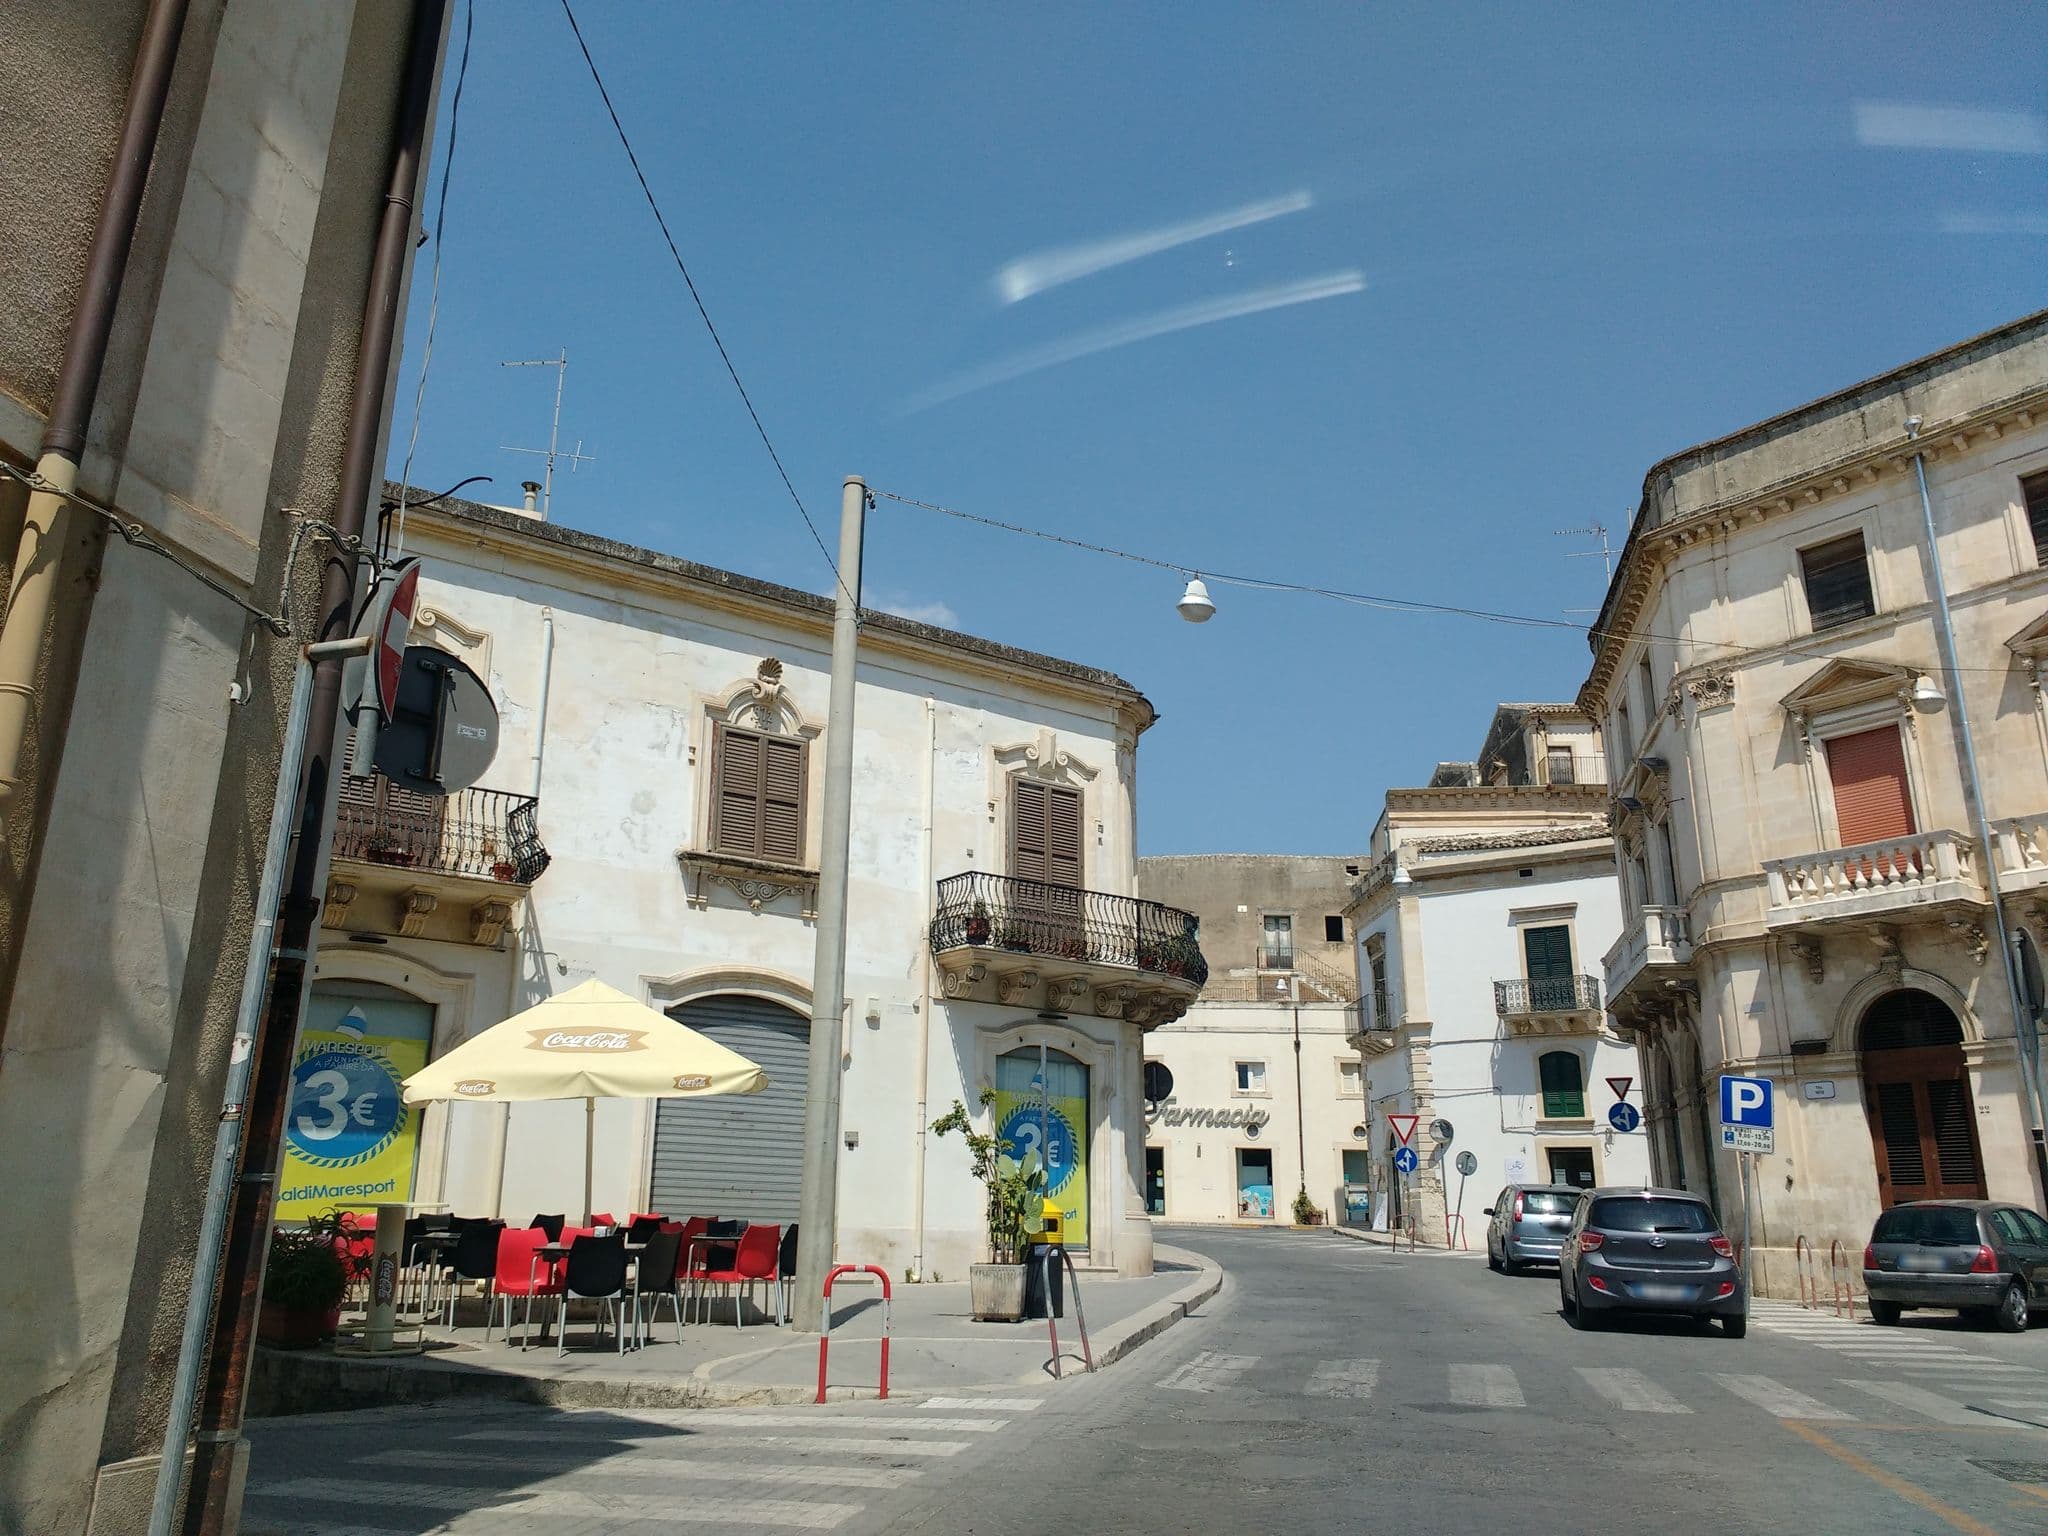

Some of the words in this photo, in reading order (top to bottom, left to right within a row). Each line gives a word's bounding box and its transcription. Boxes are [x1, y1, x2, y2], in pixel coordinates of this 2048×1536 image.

[303, 1039, 392, 1057] MARESPORT
[542, 1031, 631, 1049] Coca-Cola
[459, 1083, 490, 1093] Coca-Cola
[679, 1077, 706, 1087] Coca-Cola
[297, 1070, 349, 1141] 3
[350, 1092, 378, 1126] €
[1731, 1081, 1764, 1121] P
[1145, 1096, 1270, 1128] Farmacia
